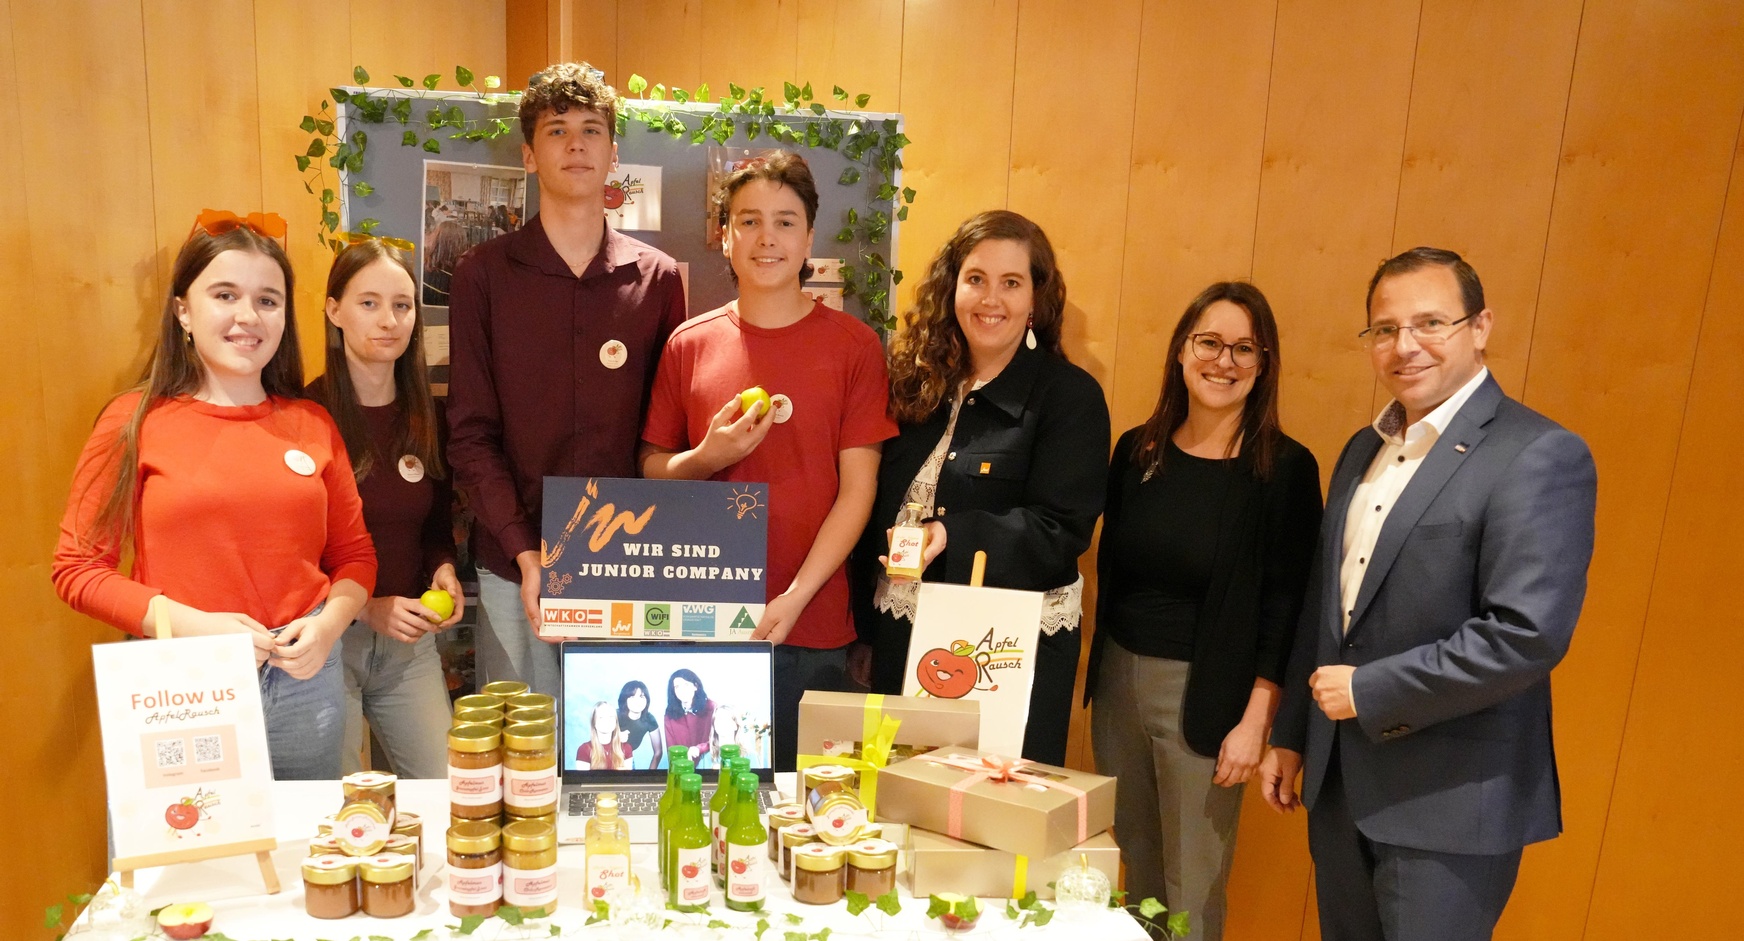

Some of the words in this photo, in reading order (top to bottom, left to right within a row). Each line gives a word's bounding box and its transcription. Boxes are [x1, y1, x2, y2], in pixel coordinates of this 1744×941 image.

[623, 542, 664, 557] WIR
[671, 544, 721, 558] SIND
[899, 538, 919, 548] Shot
[578, 563, 655, 578] JUNIOR
[663, 565, 764, 581] COMPANY
[545, 610, 586, 622] WKO
[650, 613, 670, 621] WIFI
[728, 629, 737, 637] JA
[975, 627, 1019, 653] Apfel
[975, 652, 1022, 684] Rausch
[131, 689, 204, 710] Follow
[212, 687, 236, 702] us
[599, 869, 624, 880] Shot
